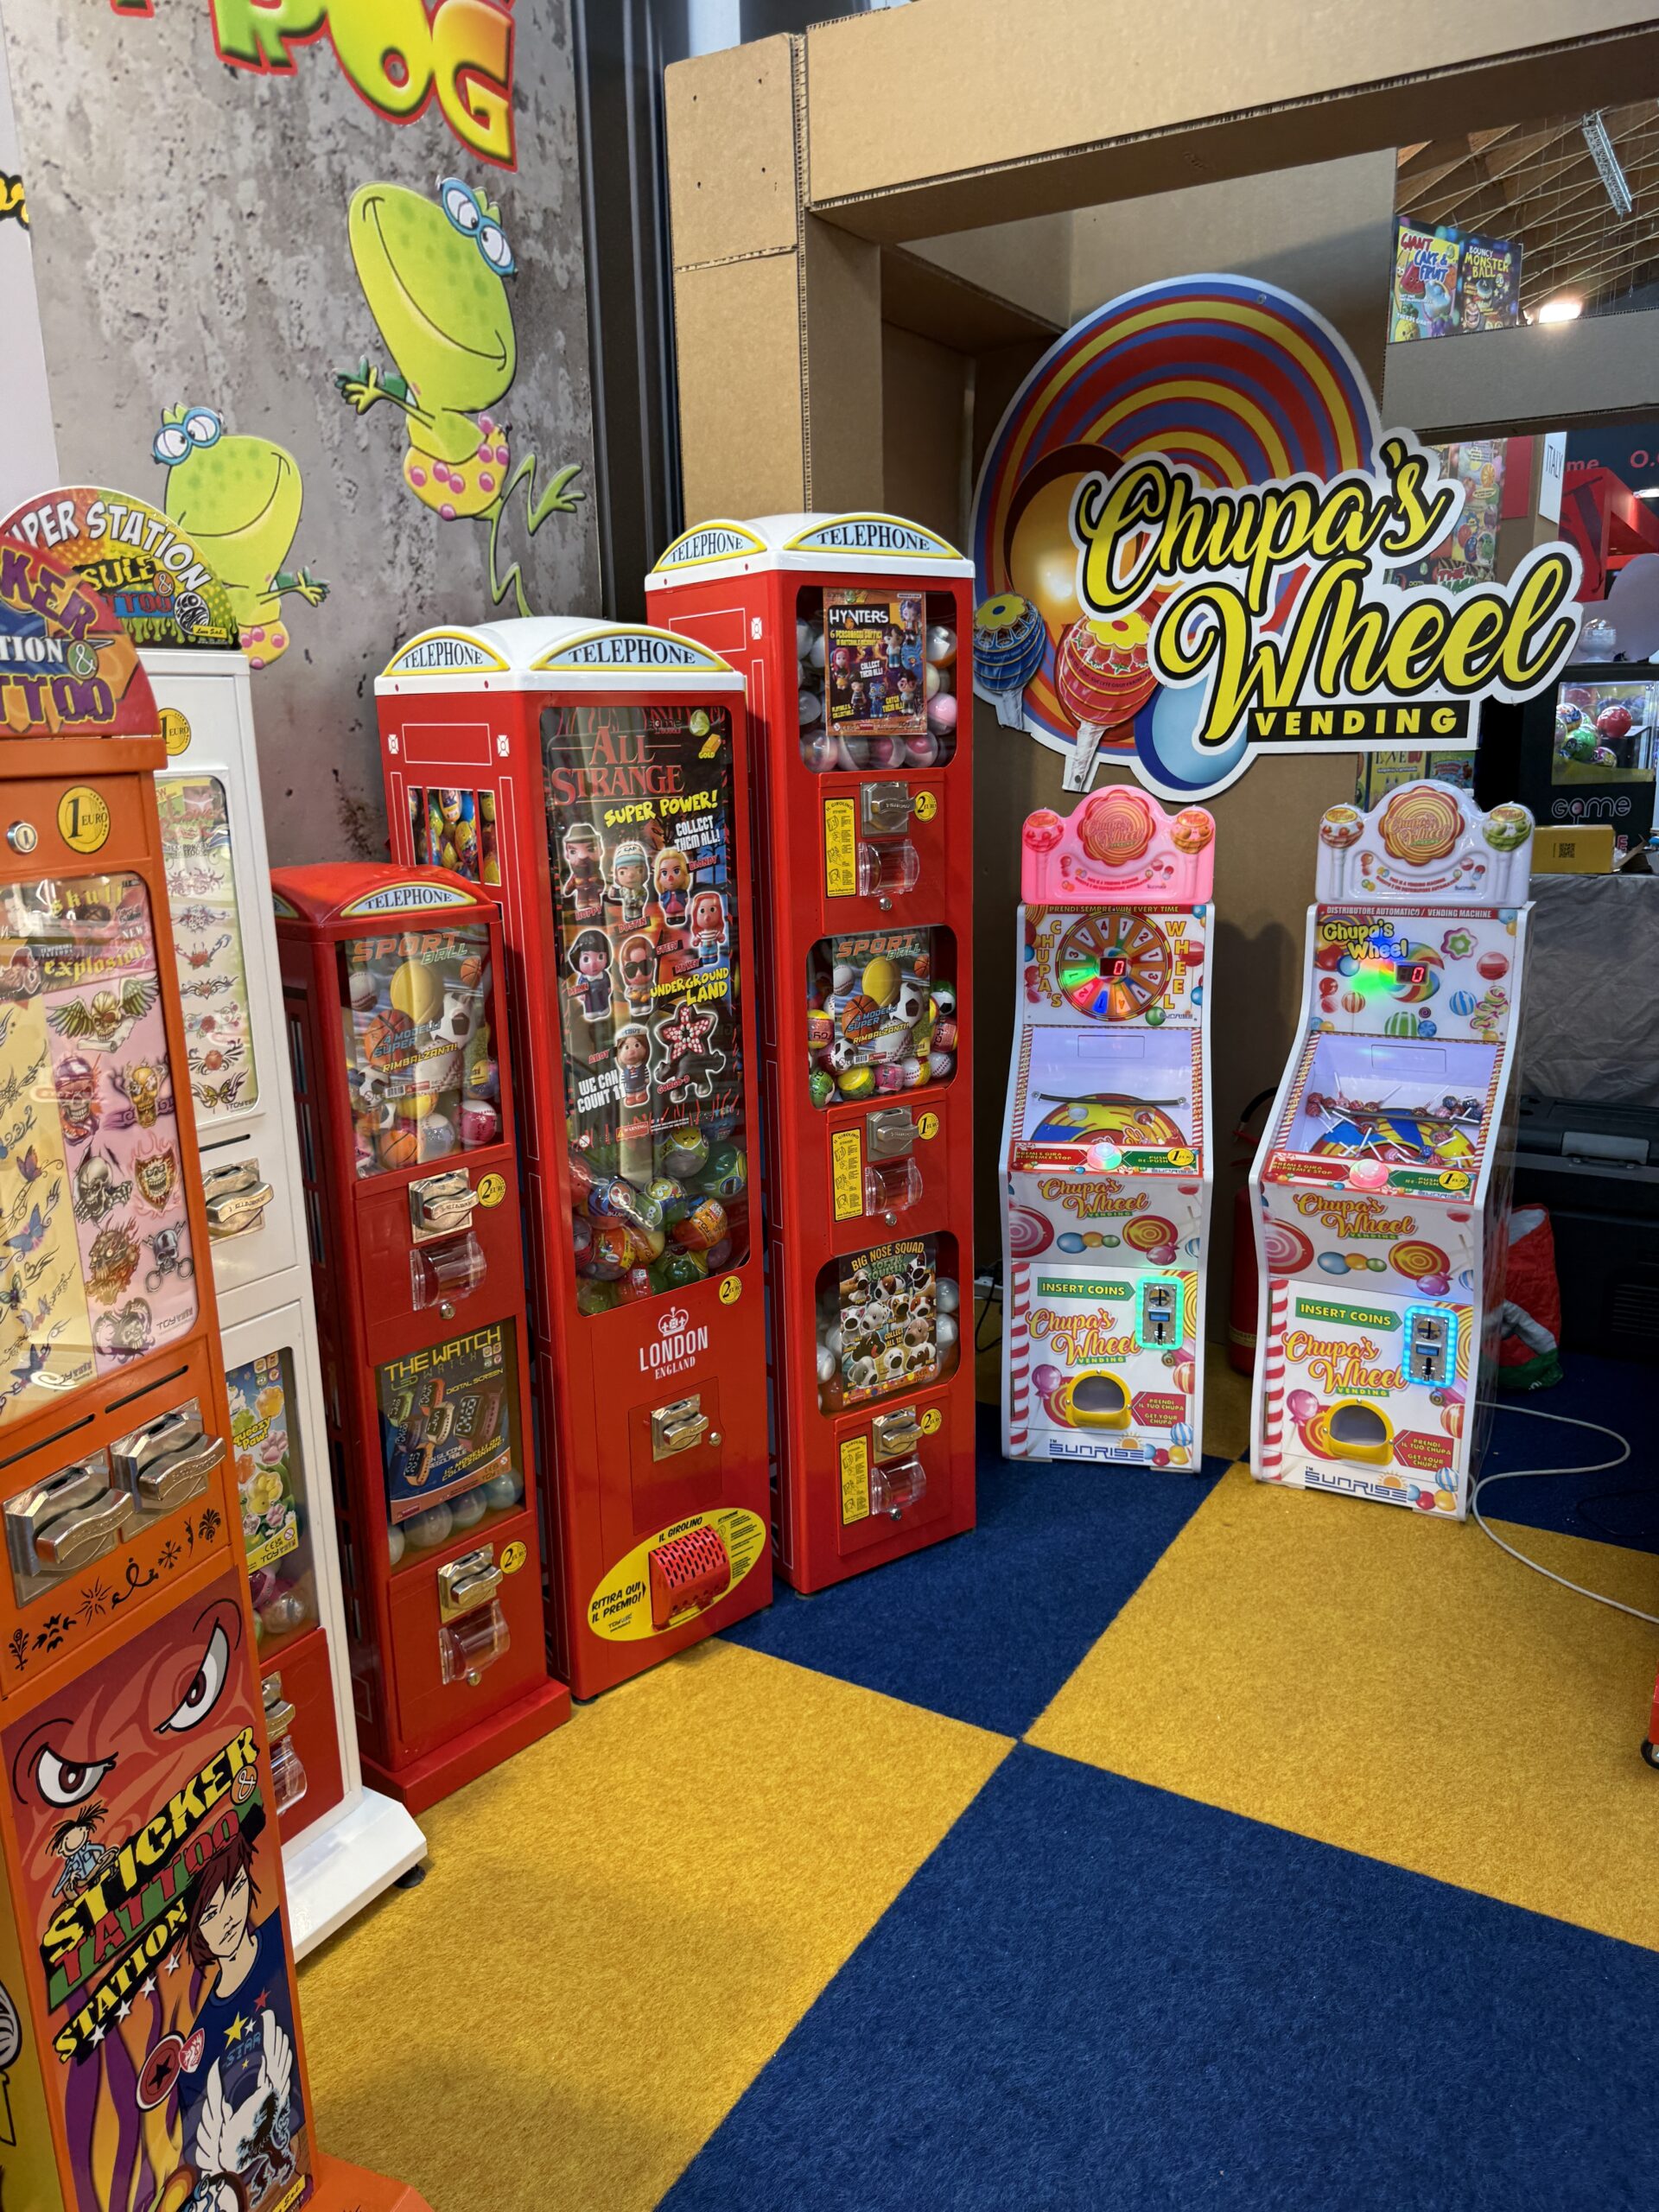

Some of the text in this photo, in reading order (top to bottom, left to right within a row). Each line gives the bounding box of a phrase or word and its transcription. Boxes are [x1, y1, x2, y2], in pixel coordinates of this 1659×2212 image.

[111, 0, 518, 172] ROG
[1401, 232, 1433, 251] GIANT
[1469, 245, 1494, 257] BOUNCY
[1419, 264, 1448, 283] FRUIT
[1465, 252, 1509, 273] MONSTER
[1472, 265, 1496, 278] BALL
[1077, 436, 1455, 613] Chupa's
[86, 500, 213, 591] STATION
[671, 531, 743, 563] TELEPHONE
[817, 524, 930, 550] TELEPHONE
[403, 642, 483, 669] TELEPHONE
[569, 639, 696, 664] TELEPHONE
[1156, 551, 1573, 748] Wheel
[169, 725, 189, 736] EURO
[1255, 709, 1458, 736] VENDING
[589, 726, 657, 766] ALL
[698, 751, 716, 760] GOLD
[551, 765, 685, 805] STRANGE
[604, 790, 718, 828] SUPER POWER!
[918, 796, 925, 814] 2
[67, 797, 107, 839] 1 EURO
[675, 815, 714, 837] COLLECT
[674, 829, 721, 853] THEM ALL!
[50, 883, 124, 918] skull
[365, 887, 453, 910] TELEPHONE
[1326, 906, 1376, 915] DISTRIBUTORE
[1376, 907, 1420, 916] AUTOMATICO
[121, 926, 143, 939] NEW
[1323, 919, 1395, 942] Chupa's
[353, 931, 461, 963] SPORT
[422, 943, 467, 965] BALL
[836, 934, 916, 958] SPORT
[887, 943, 920, 961] BALL
[1347, 938, 1408, 960] Wheel
[44, 940, 146, 982] explosion
[1114, 960, 1123, 976] 0
[650, 967, 729, 998] UNDERGROUND
[1411, 966, 1425, 982] 0
[686, 982, 728, 1007] LAND
[862, 1003, 898, 1020] MODELLI
[848, 1018, 880, 1032] SUPER
[373, 1039, 416, 1058] SUPER
[383, 1043, 457, 1072] RIMBALZANTI!
[579, 1069, 619, 1096] WE CAN
[577, 1090, 611, 1114] COUNT
[919, 1117, 927, 1135] 1
[1173, 1150, 1179, 1161] 1
[481, 1179, 505, 1198] 2 EURO
[1038, 1178, 1122, 1200] Chupa's
[1444, 1173, 1452, 1185] 1
[1063, 1192, 1149, 1219] Wheel
[1293, 1192, 1386, 1216] Chupa's
[1320, 1212, 1417, 1238] Wheel
[851, 1242, 924, 1271] BIG NOSE SQUAD
[722, 1281, 731, 1298] 2
[1042, 1282, 1125, 1295] INSERT COINS
[1025, 1307, 1116, 1339] Chupa's
[1300, 1303, 1391, 1326] INSERT COINS
[385, 1325, 501, 1382] THE WATCH
[639, 1325, 709, 1373] LONDON
[1051, 1329, 1141, 1367] Wheel
[1281, 1330, 1379, 1363] Chupa's
[474, 1368, 505, 1385] SCREEN
[654, 1356, 696, 1380] ENGLAND
[1308, 1358, 1409, 1395] Wheel
[1337, 1387, 1388, 1396] VENDING
[923, 1414, 931, 1429] 2
[242, 1428, 270, 1452] Paw!
[1409, 1443, 1425, 1452] TUO
[1426, 1445, 1452, 1456] CHUPA
[1413, 1438, 1440, 1446] PRENDI
[1049, 1443, 1145, 1462] SUNRISE
[1407, 1452, 1444, 1465] GET YOUR
[1412, 1459, 1439, 1469] CHUPA
[1304, 1470, 1408, 1503] SUNRISE
[659, 1516, 702, 1542] IL GIROLINO
[504, 1548, 513, 1569] 2
[591, 1580, 641, 1612] RITIRA QUI
[592, 1612, 600, 1624] IL
[602, 1591, 641, 1618] PREMIO!
[43, 1726, 257, 1965] STICKER
[55, 1809, 240, 1986] TATTOO
[55, 1896, 188, 2063] STATION
[226, 2031, 261, 2069] STAR
